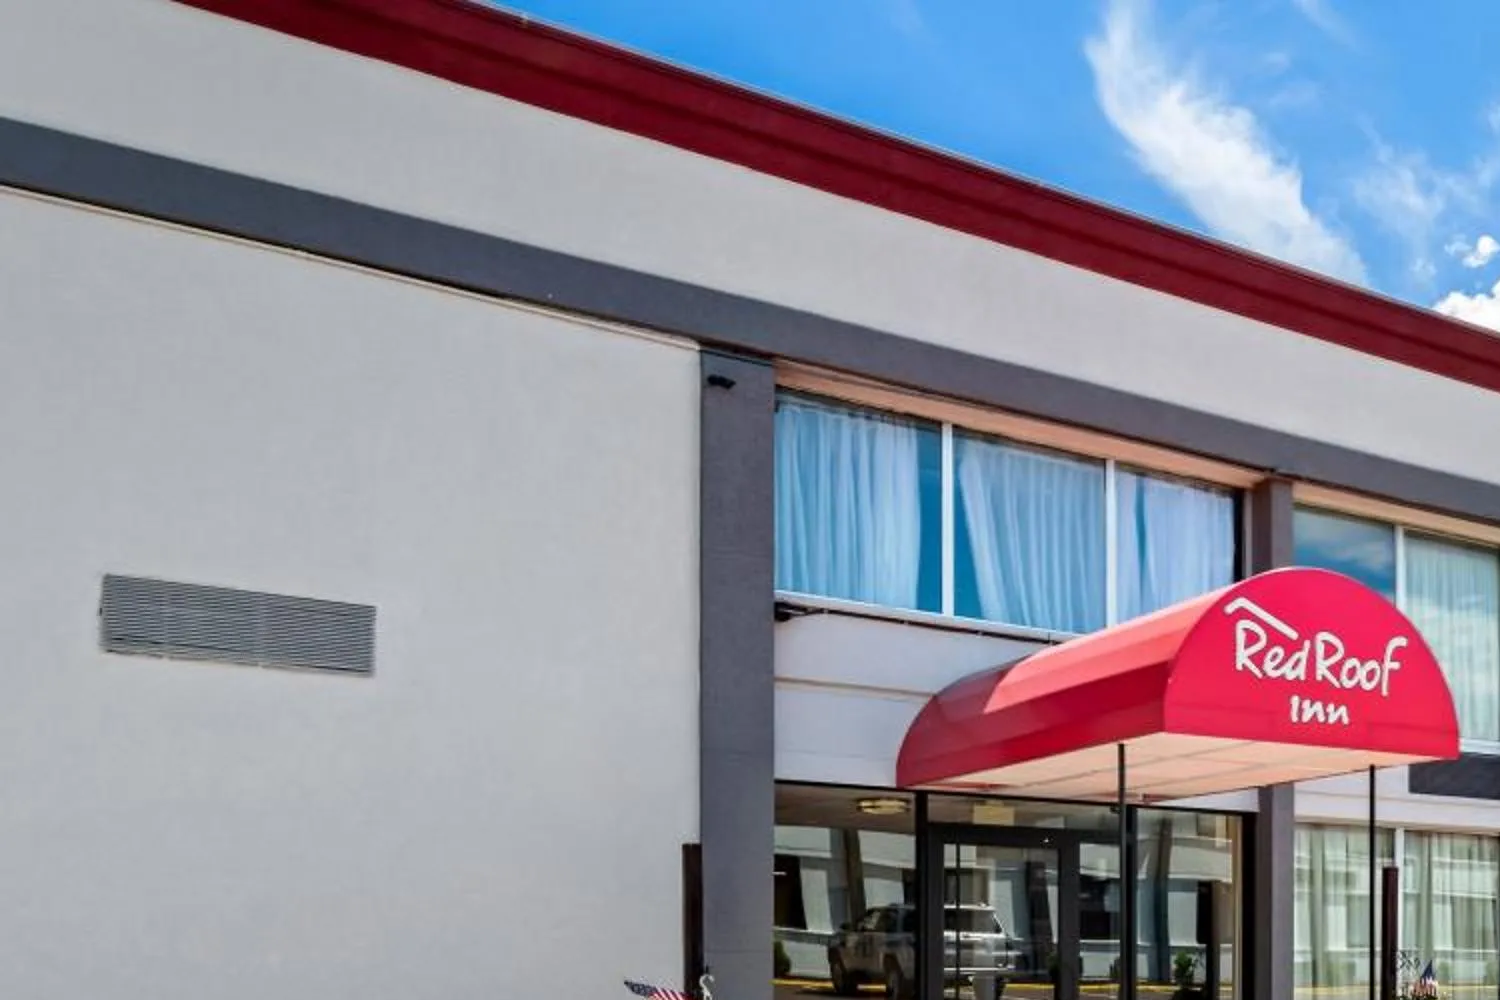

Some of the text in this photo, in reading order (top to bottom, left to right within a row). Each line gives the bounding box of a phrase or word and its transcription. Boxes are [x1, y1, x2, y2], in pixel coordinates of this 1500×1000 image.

[1235, 619, 1408, 697] Red Roof
[1290, 695, 1350, 725] Inn
